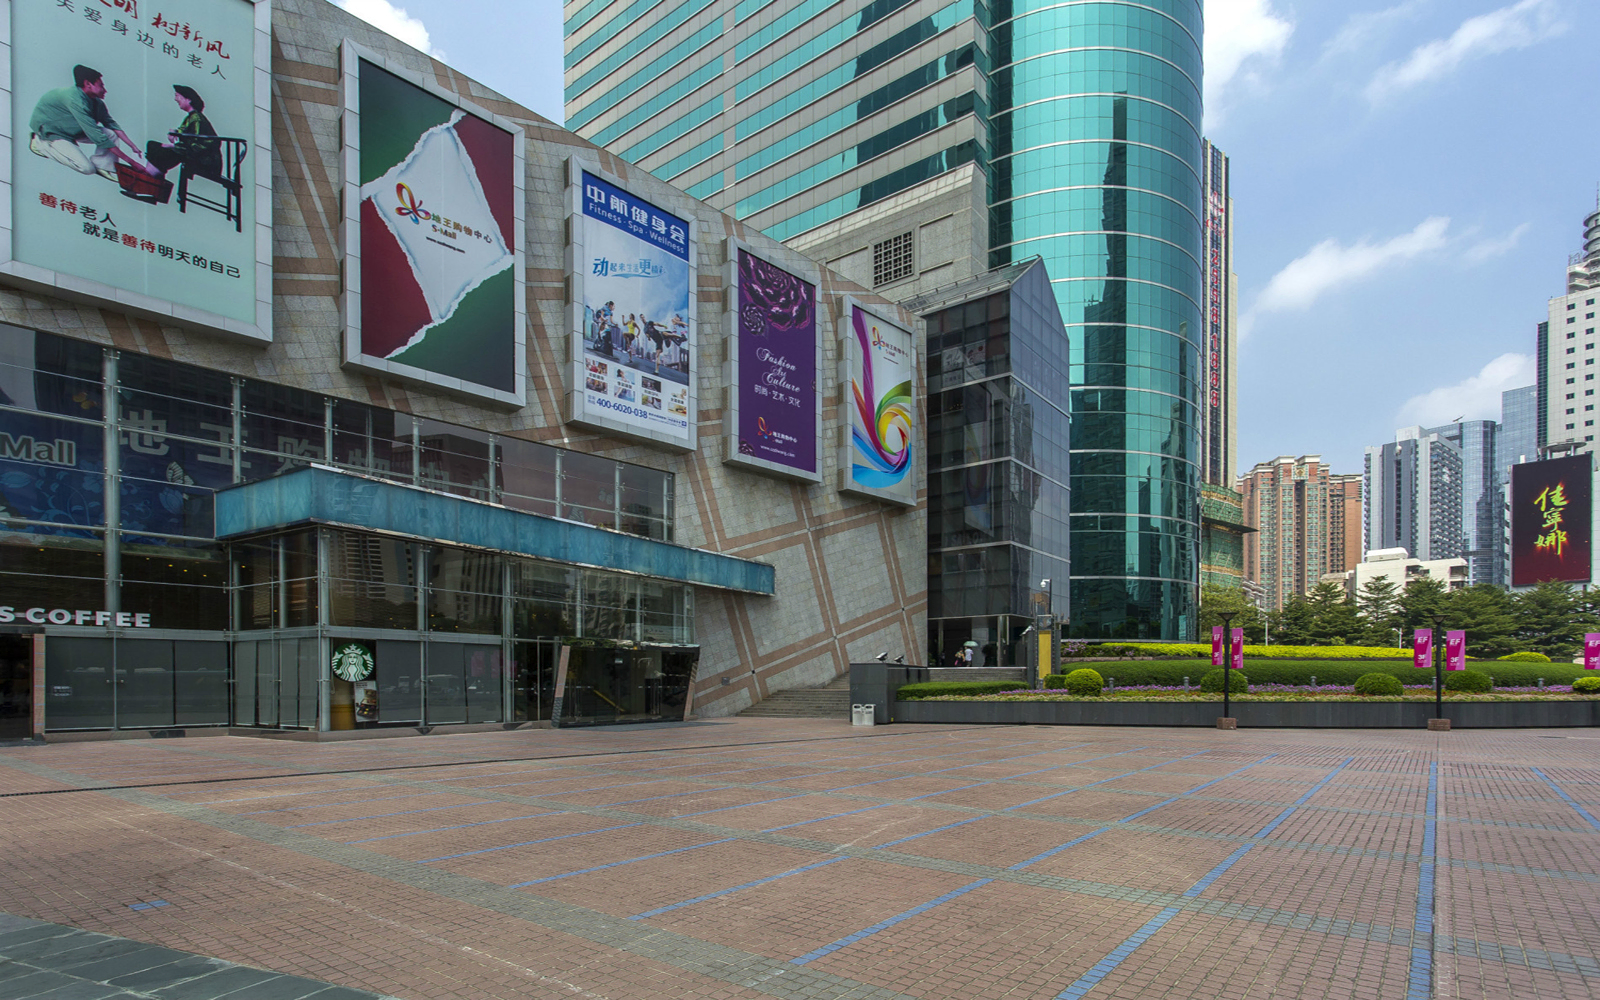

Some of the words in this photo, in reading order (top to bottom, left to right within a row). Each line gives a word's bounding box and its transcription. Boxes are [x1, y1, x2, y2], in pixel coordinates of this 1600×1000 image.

[38, 192, 117, 228] 善待老人
[586, 184, 686, 245] 中航健身会
[589, 202, 622, 224] Fitness
[628, 221, 644, 234] Spa
[649, 230, 685, 254] Wellness
[82, 221, 241, 279] 就是善待明天的自己
[756, 347, 797, 371] Fashion
[762, 372, 800, 393] Culture
[596, 397, 648, 419] 400-6020-038
[25, 608, 151, 628] COFFEE
[1449, 638, 1461, 646] EF
